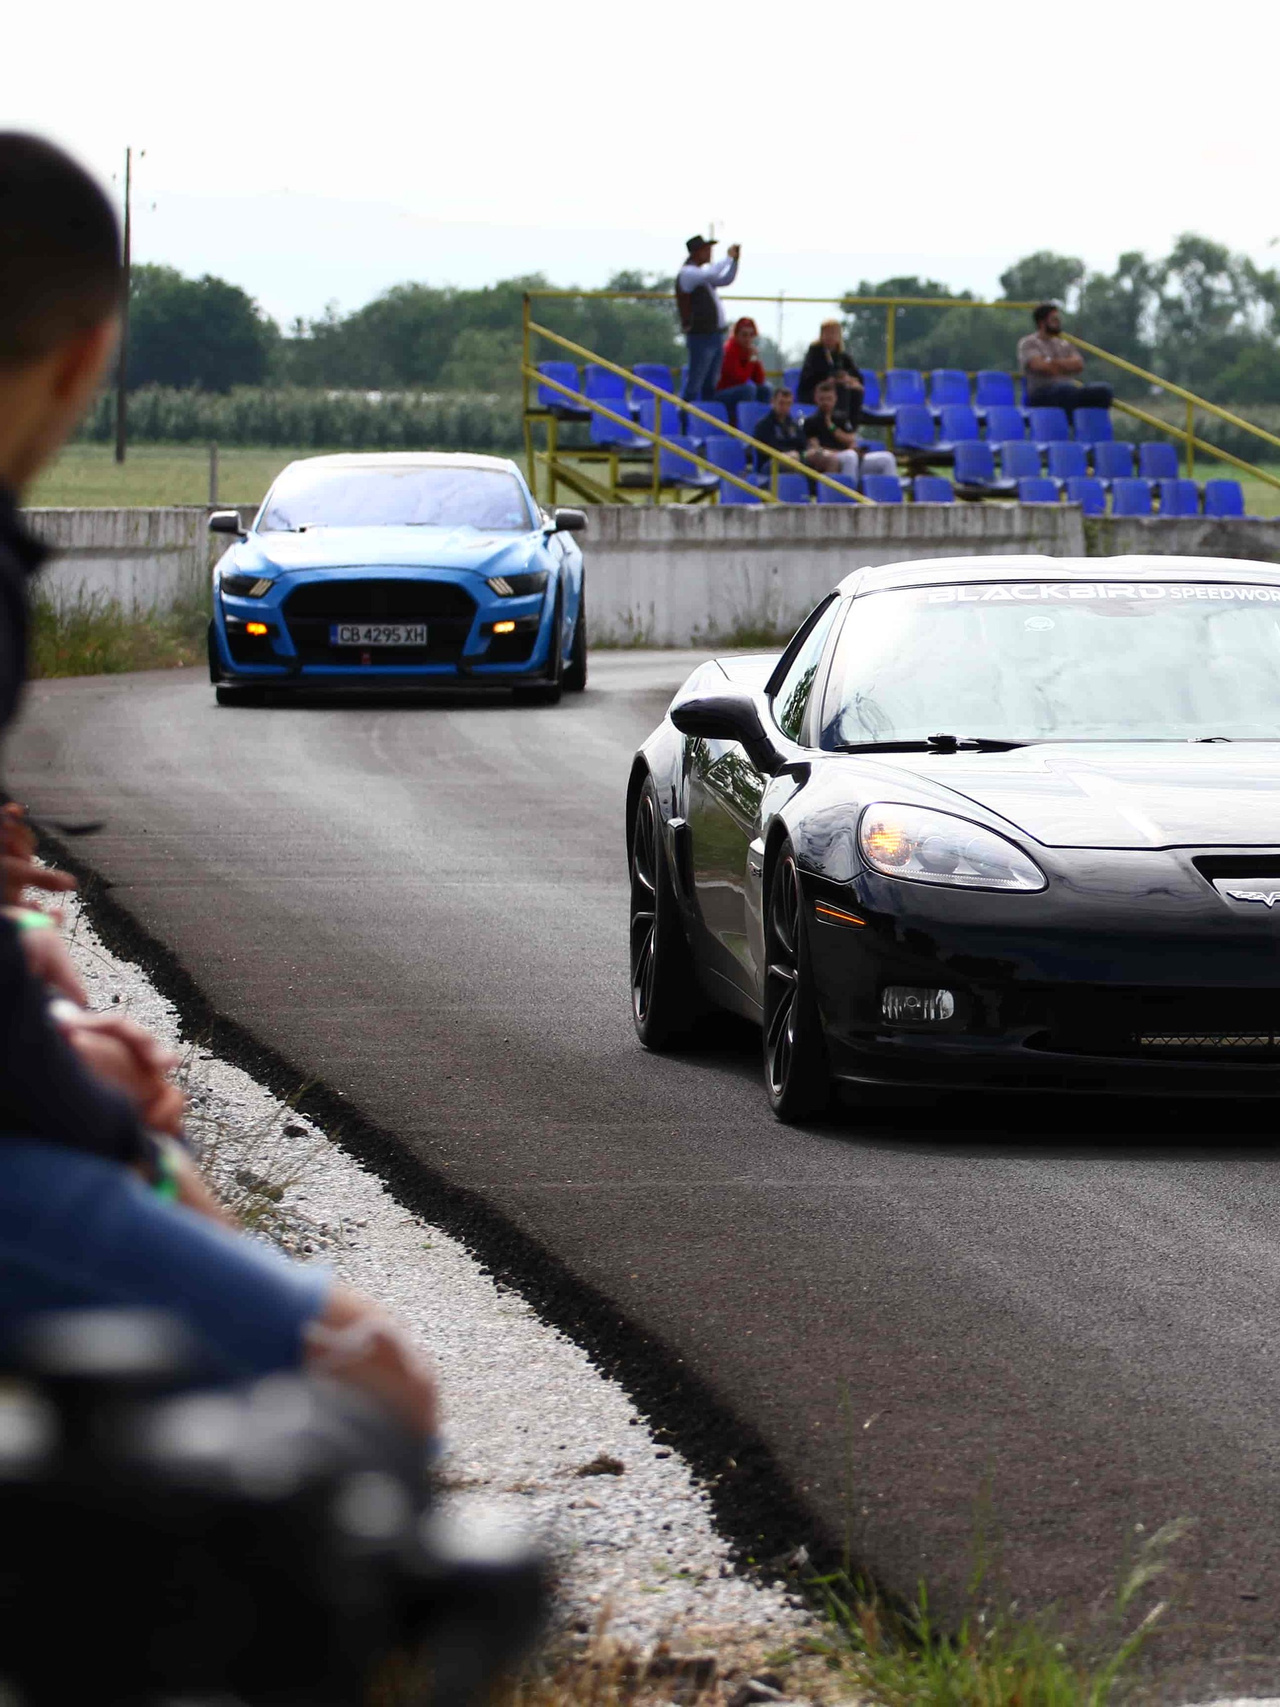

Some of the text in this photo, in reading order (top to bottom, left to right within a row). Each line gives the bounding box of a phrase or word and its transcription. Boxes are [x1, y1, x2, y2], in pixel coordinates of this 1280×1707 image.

[928, 584, 1166, 603] BLACKBIRD
[340, 626, 425, 642] CB 4295 XH
